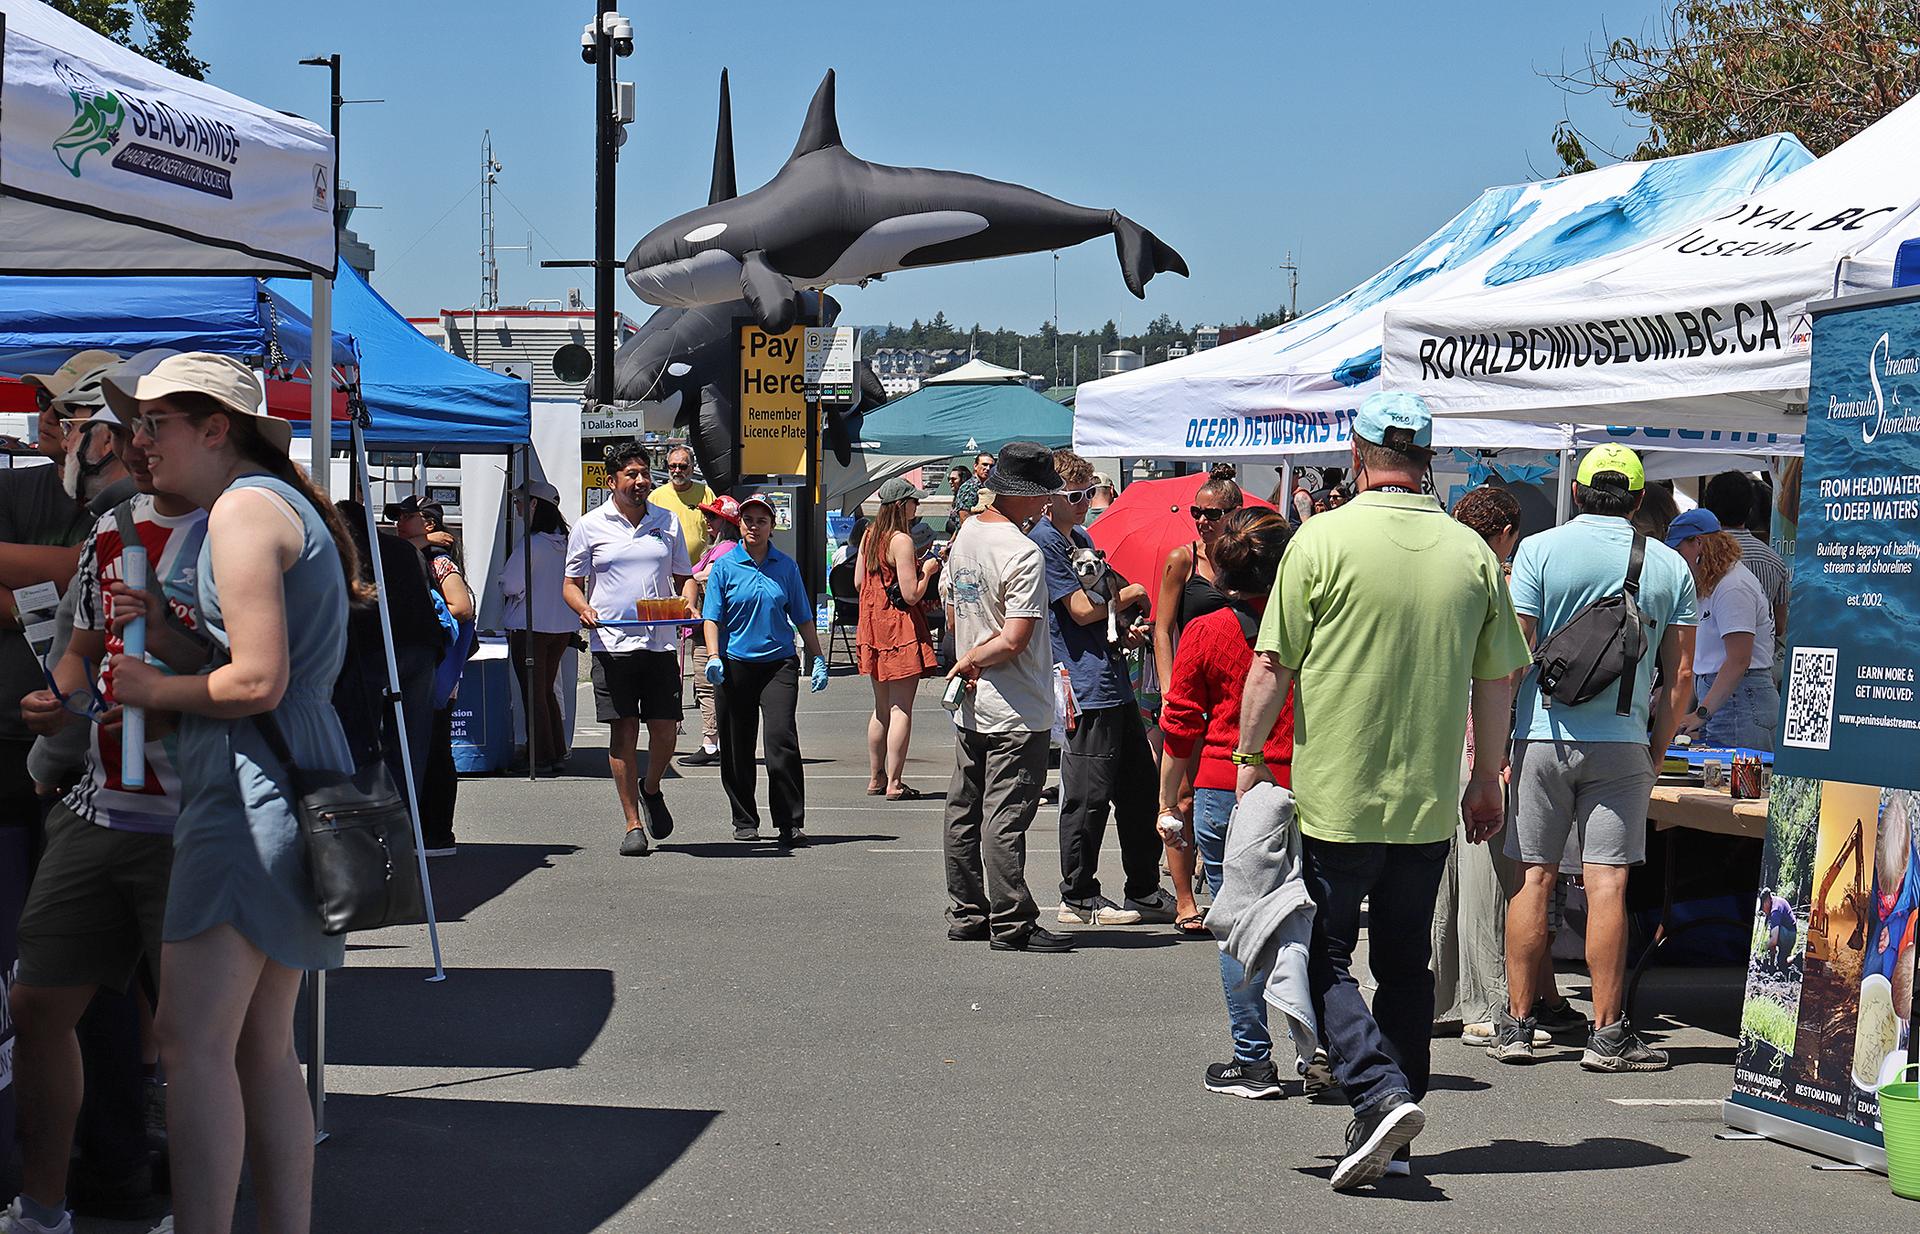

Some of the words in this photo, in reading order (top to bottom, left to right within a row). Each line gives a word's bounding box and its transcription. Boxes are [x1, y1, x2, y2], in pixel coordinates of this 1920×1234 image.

[114, 89, 240, 164] SEACHANGE
[119, 148, 152, 171] MARINE
[150, 151, 205, 186] CONSERVATION
[203, 170, 231, 192] SOCIETY
[1808, 206, 1898, 231] BC
[750, 332, 799, 364] Pay
[1420, 300, 1781, 380] ROYALBCMUSEUM.BC.CA
[744, 369, 805, 394] Here
[749, 407, 801, 420] Remember
[1827, 391, 1877, 420] Peninsula
[1891, 385, 1901, 405] &
[588, 420, 615, 429] Dallas
[616, 418, 638, 429] Road
[744, 425, 779, 438] Licence
[782, 425, 806, 438] Plate
[1185, 417, 1239, 447] OCEAN
[1240, 411, 1330, 446] NETWORKS
[587, 466, 607, 475] PAY
[1820, 478, 1851, 498] FROM
[1852, 475, 1920, 496] HEADWATER
[1825, 503, 1842, 521] TO
[1843, 502, 1871, 520] DEEP
[1873, 500, 1919, 520] WATERS
[1817, 542, 1848, 559] Building
[1849, 546, 1854, 556] a
[1856, 541, 1880, 558] legacy
[1883, 541, 1893, 555] of
[1893, 540, 1920, 559] healthy
[1823, 561, 1855, 573] streams
[1856, 560, 1871, 573] and
[1871, 559, 1912, 574] shorelines
[1862, 593, 1882, 606] 2002
[1857, 666, 1884, 680] LEARN
[1885, 667, 1906, 681] MORE
[1907, 669, 1914, 682] &
[1856, 685, 1871, 698] GET
[1872, 686, 1914, 701] INVOLVED:
[1736, 1068, 1782, 1090] STEWARDSHIP
[1795, 1084, 1842, 1106] RESTORATION
